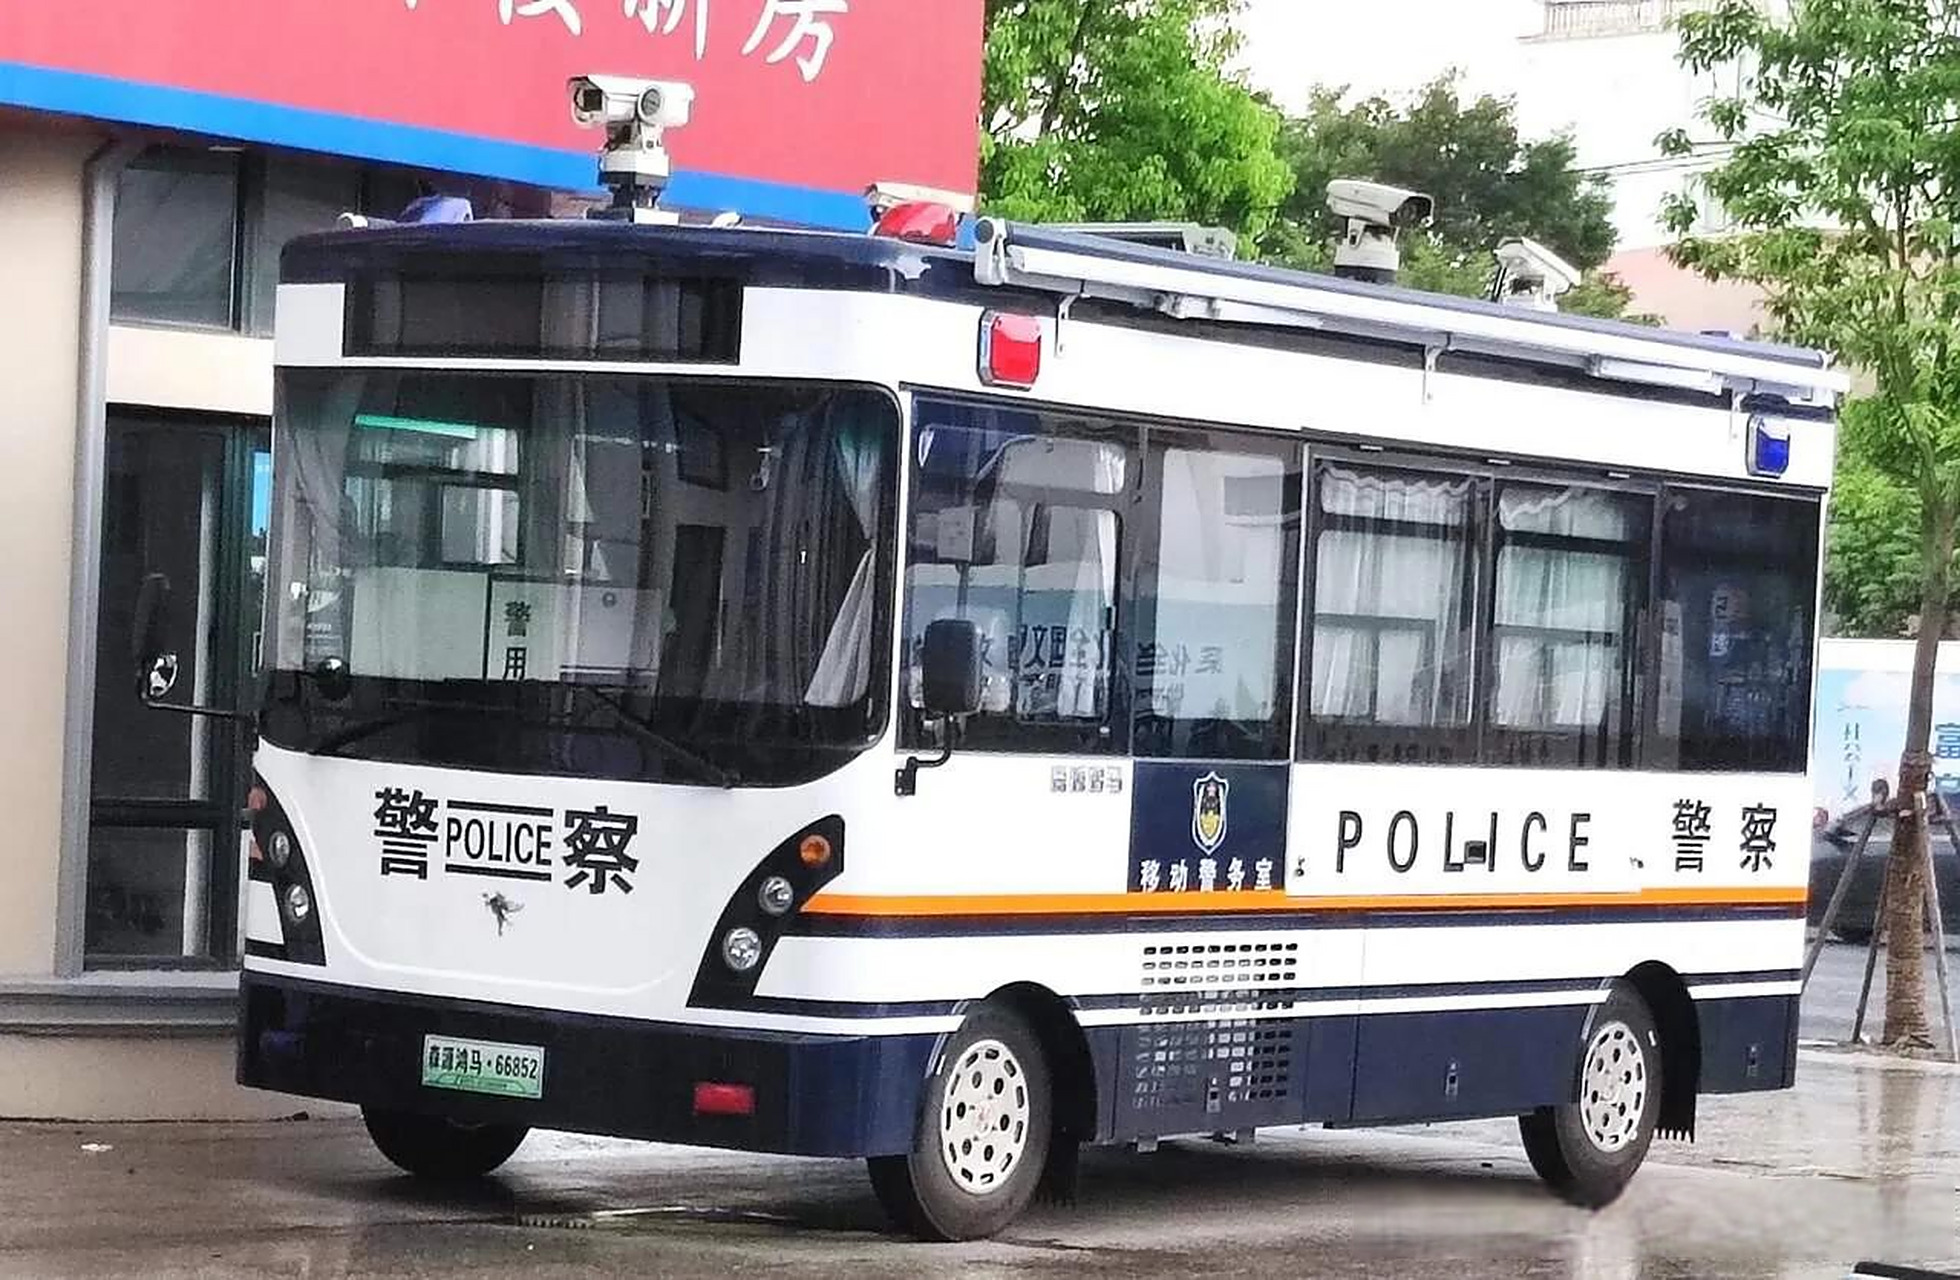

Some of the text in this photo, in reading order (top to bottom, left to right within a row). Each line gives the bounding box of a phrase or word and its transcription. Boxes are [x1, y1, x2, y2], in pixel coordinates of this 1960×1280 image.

[504, 600, 532, 681] 警用
[374, 787, 640, 895] 警 POLICE 察
[1139, 856, 1274, 893] 移动警务室
[1335, 798, 1777, 874] POLICE 警察
